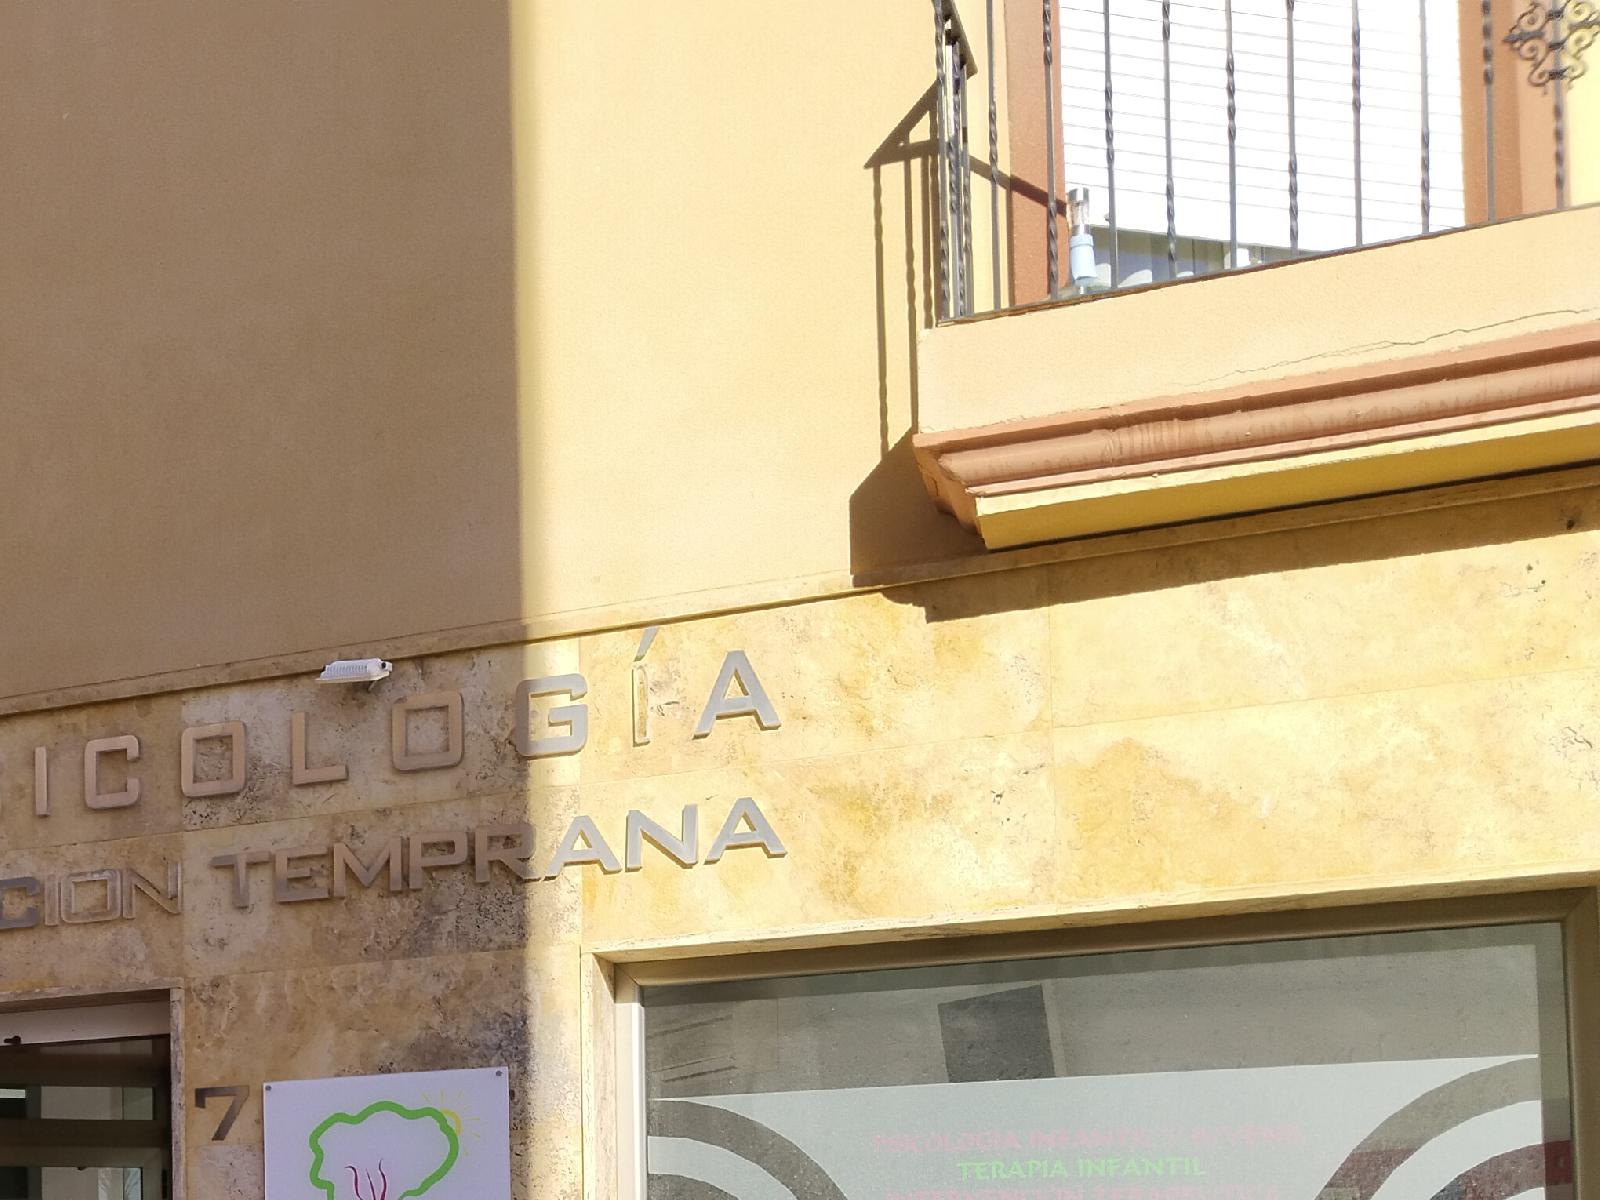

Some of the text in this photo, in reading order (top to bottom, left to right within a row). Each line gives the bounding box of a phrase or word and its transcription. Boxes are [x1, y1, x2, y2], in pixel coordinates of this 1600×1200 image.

[209, 797, 789, 909] TEMPRANA
[194, 1084, 250, 1141] 7
[957, 1156, 1207, 1182] TERAPIA INFANTIL
